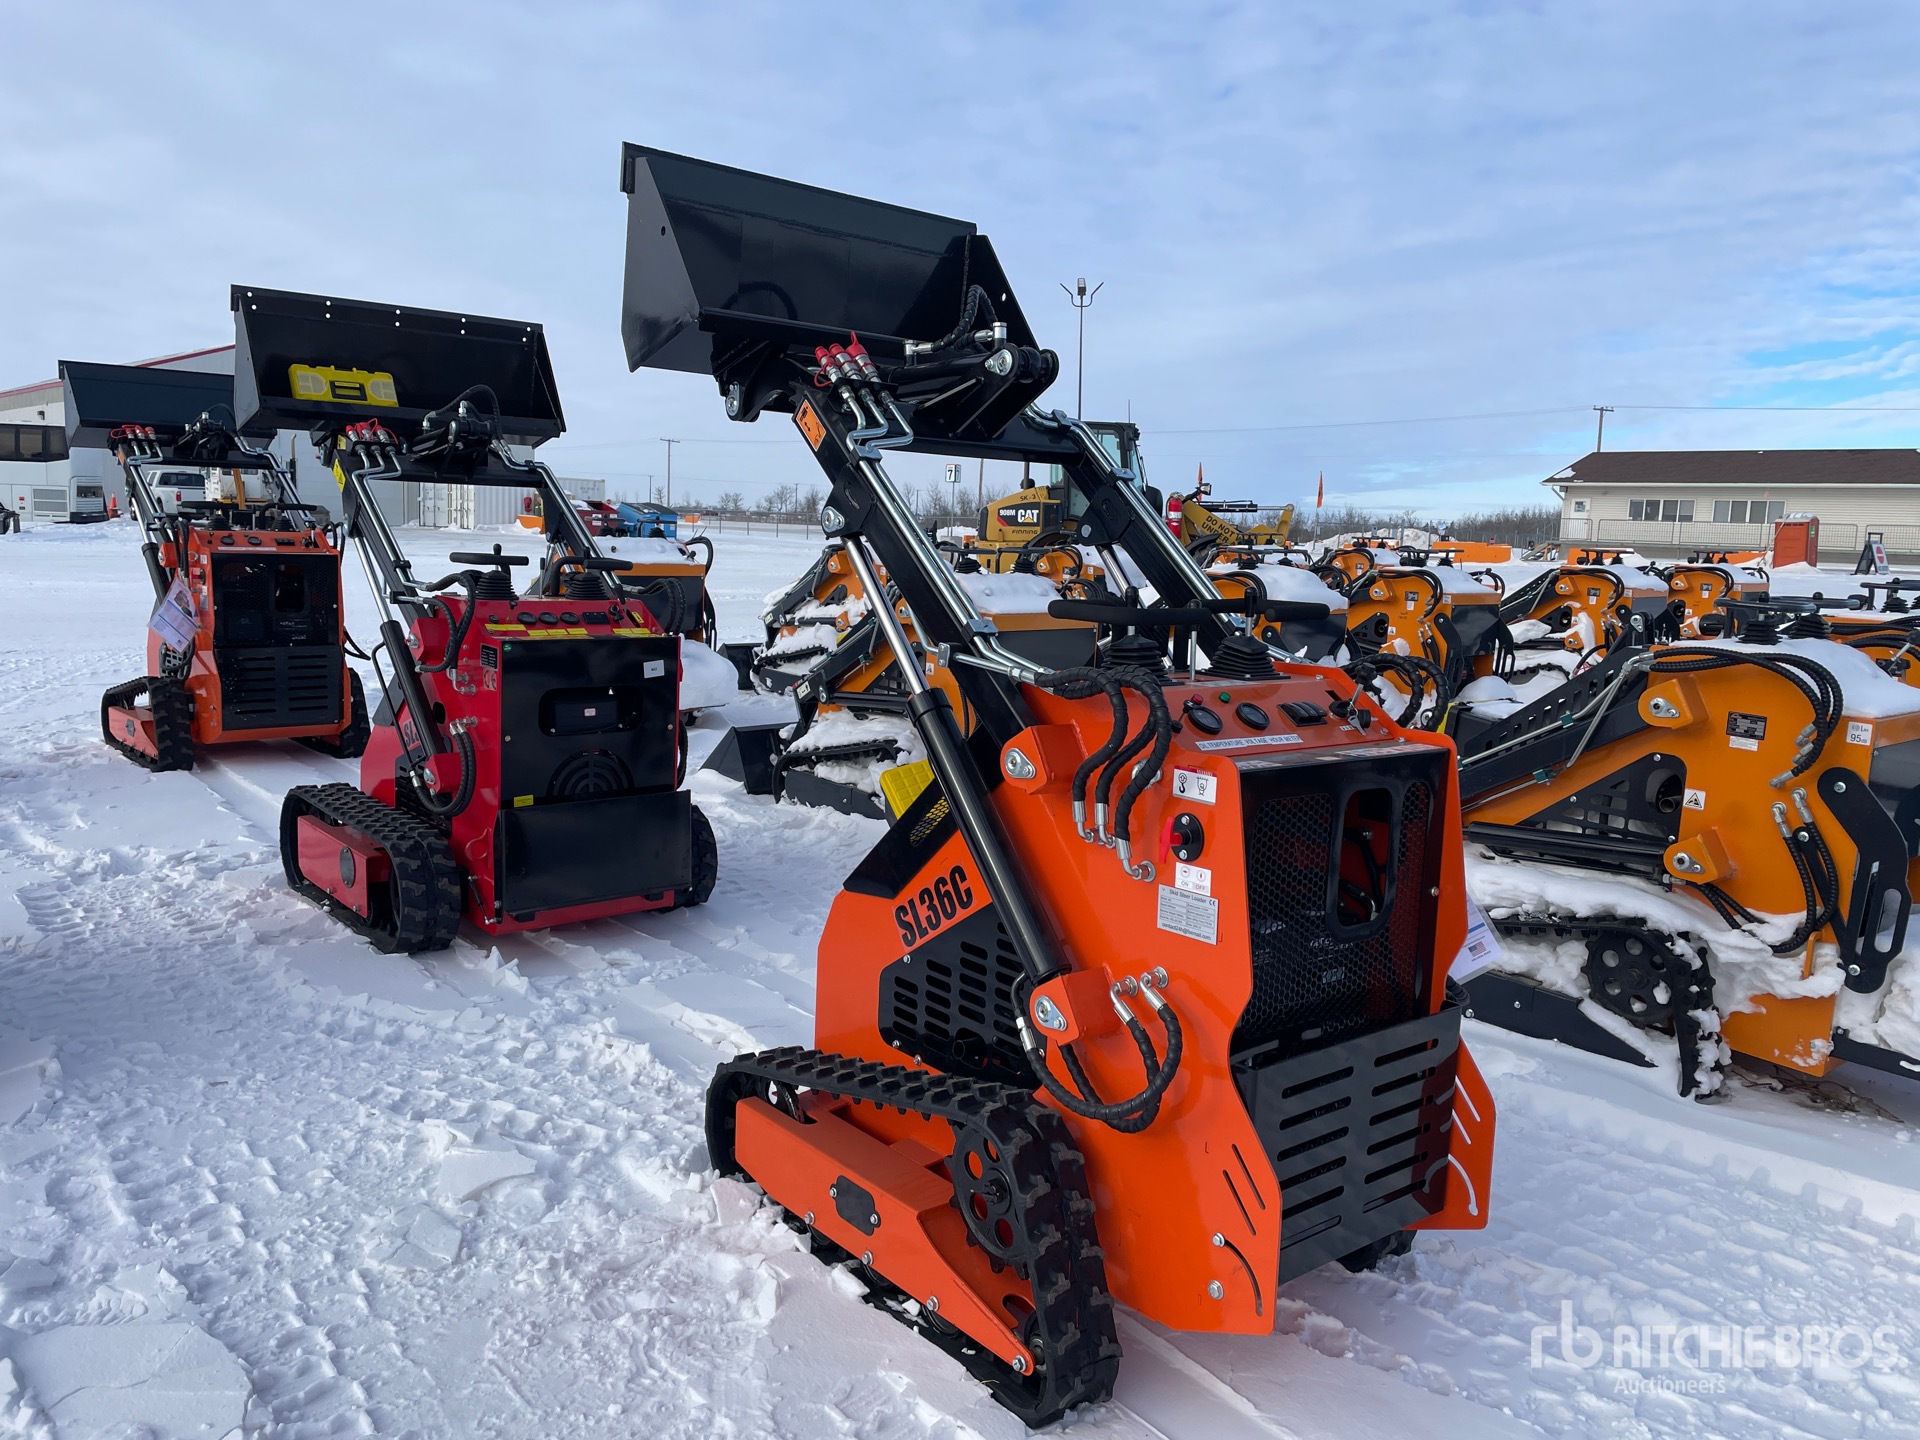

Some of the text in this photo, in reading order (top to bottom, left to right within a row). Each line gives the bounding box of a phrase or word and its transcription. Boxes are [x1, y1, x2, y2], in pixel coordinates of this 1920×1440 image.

[947, 469, 954, 480] 7
[1017, 509, 1039, 523] CAT
[1206, 515, 1236, 538] DO NOT
[404, 720, 420, 747] SL
[894, 865, 974, 947] SL36C
[1191, 894, 1206, 903] Loader
